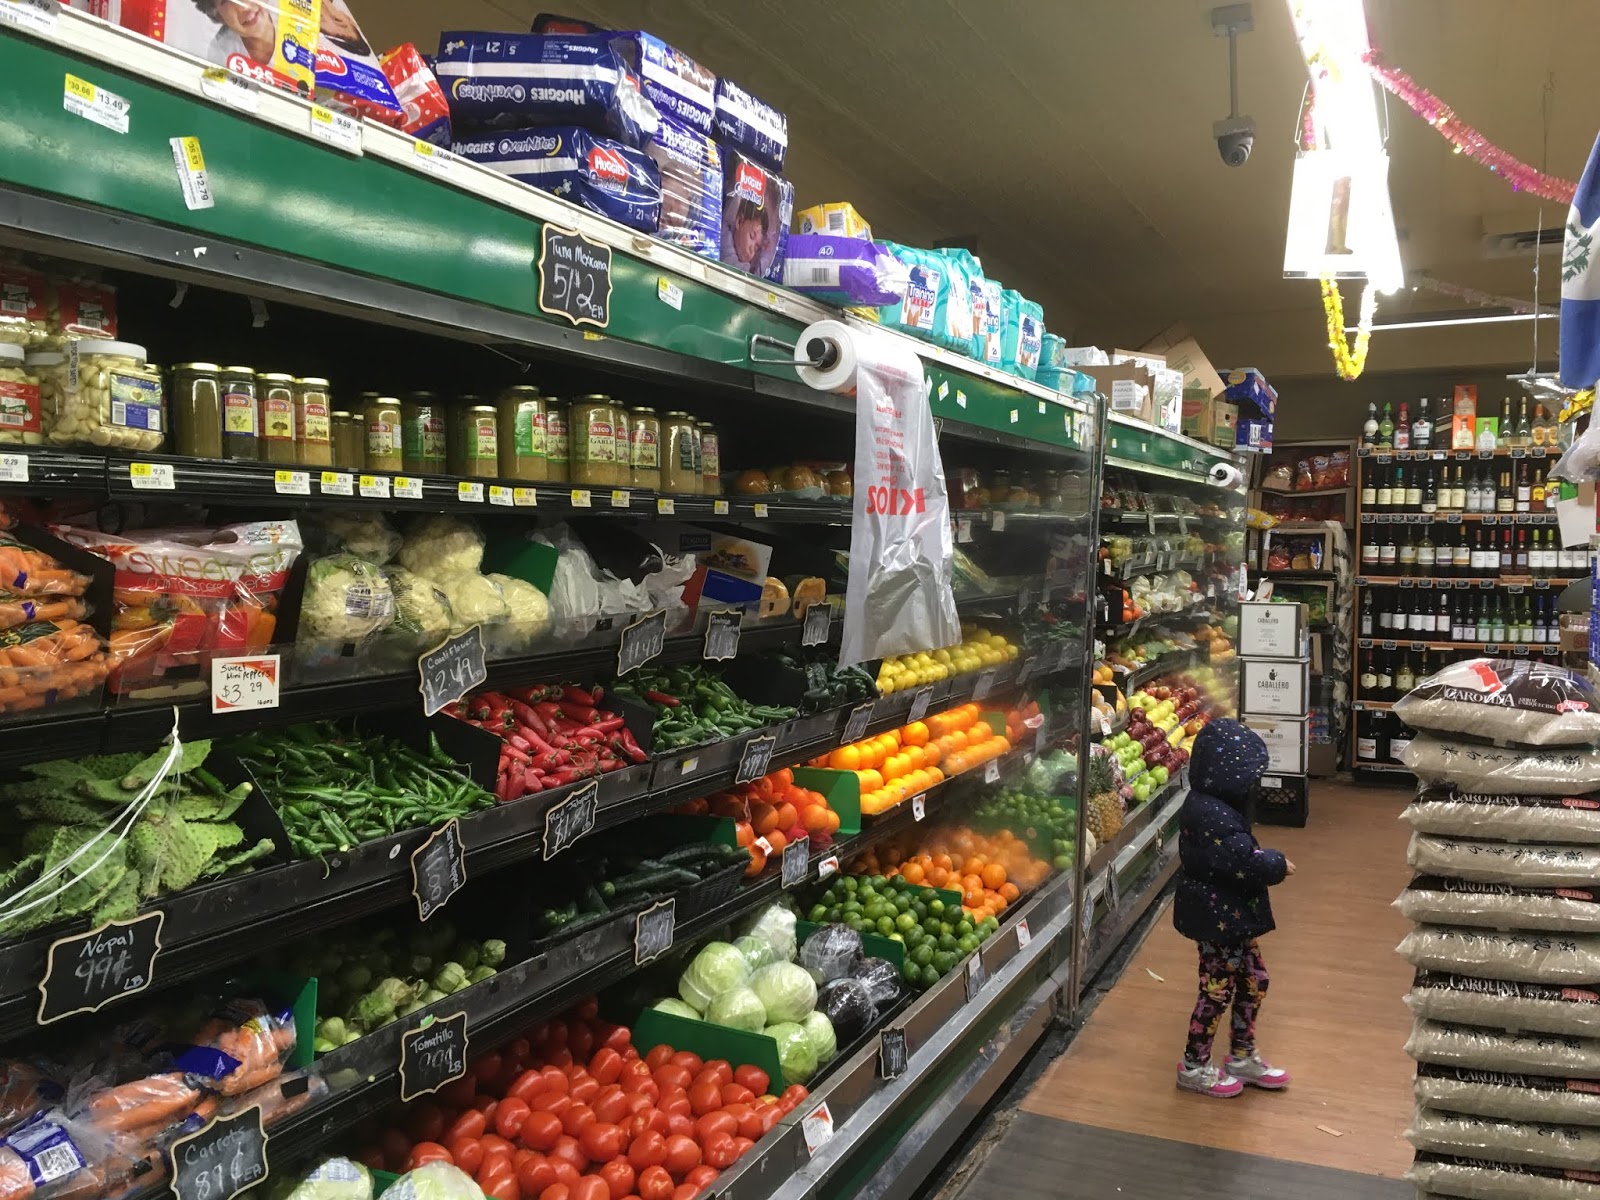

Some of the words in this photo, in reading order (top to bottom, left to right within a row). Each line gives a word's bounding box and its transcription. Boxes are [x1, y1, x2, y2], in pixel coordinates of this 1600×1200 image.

[485, 41, 501, 54] 21
[509, 45, 517, 55] 5
[531, 87, 587, 106] HUGGIES
[676, 98, 712, 132] HUGGIES
[450, 142, 495, 156] HUGGIES
[594, 155, 626, 176] HUGGIES
[635, 209, 644, 221] 21
[548, 235, 573, 262] Tuna
[1257, 680, 1290, 690] CABALLERO
[1443, 687, 1516, 707] CAROLINA
[1449, 791, 1520, 806] CAROLINA
[548, 807, 565, 824] Red
[1443, 880, 1514, 895] CAROLINA
[79, 929, 134, 958] Nopal
[123, 975, 144, 991] LB
[1449, 974, 1520, 996] CAROLINA
[409, 1027, 454, 1054] Tomatillo
[1456, 1068, 1527, 1088] CAROLINA
[184, 1125, 245, 1166] Carrots
